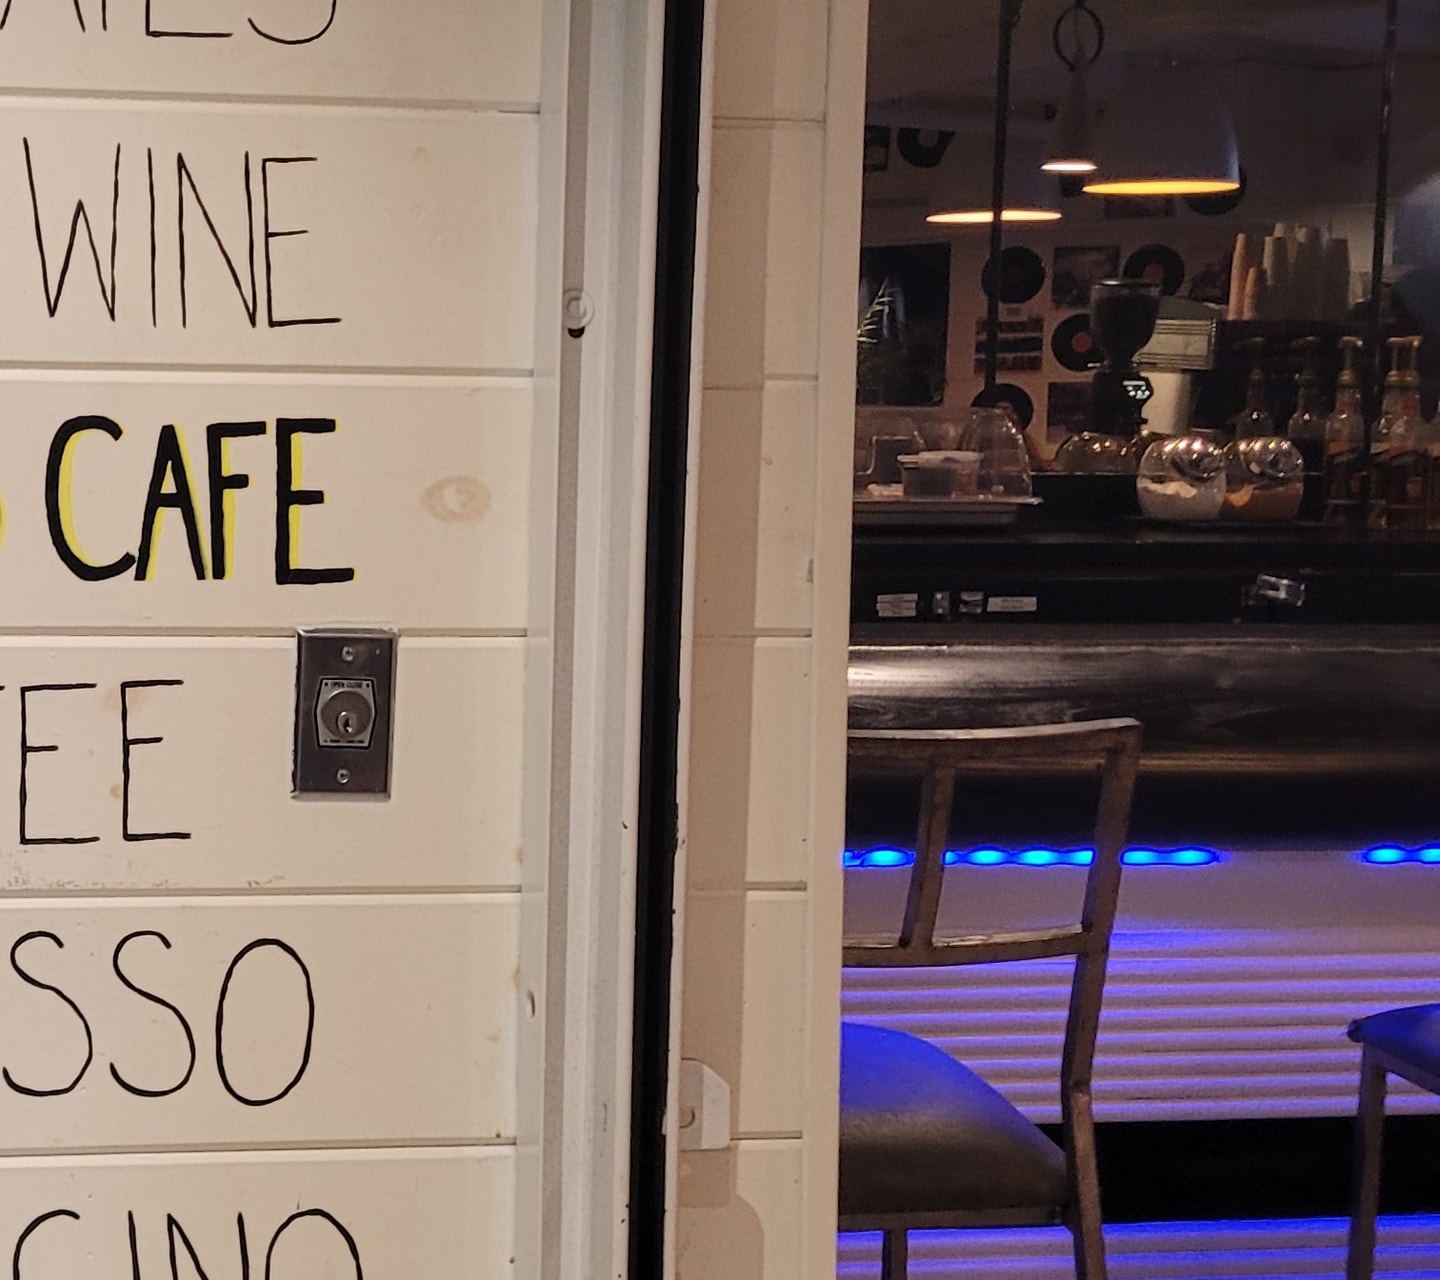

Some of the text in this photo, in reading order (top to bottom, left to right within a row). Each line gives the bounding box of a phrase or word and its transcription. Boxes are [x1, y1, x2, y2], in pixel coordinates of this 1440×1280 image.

[22, 136, 343, 331] WINE
[43, 403, 358, 587] CAFE
[330, 681, 345, 689] OPEN
